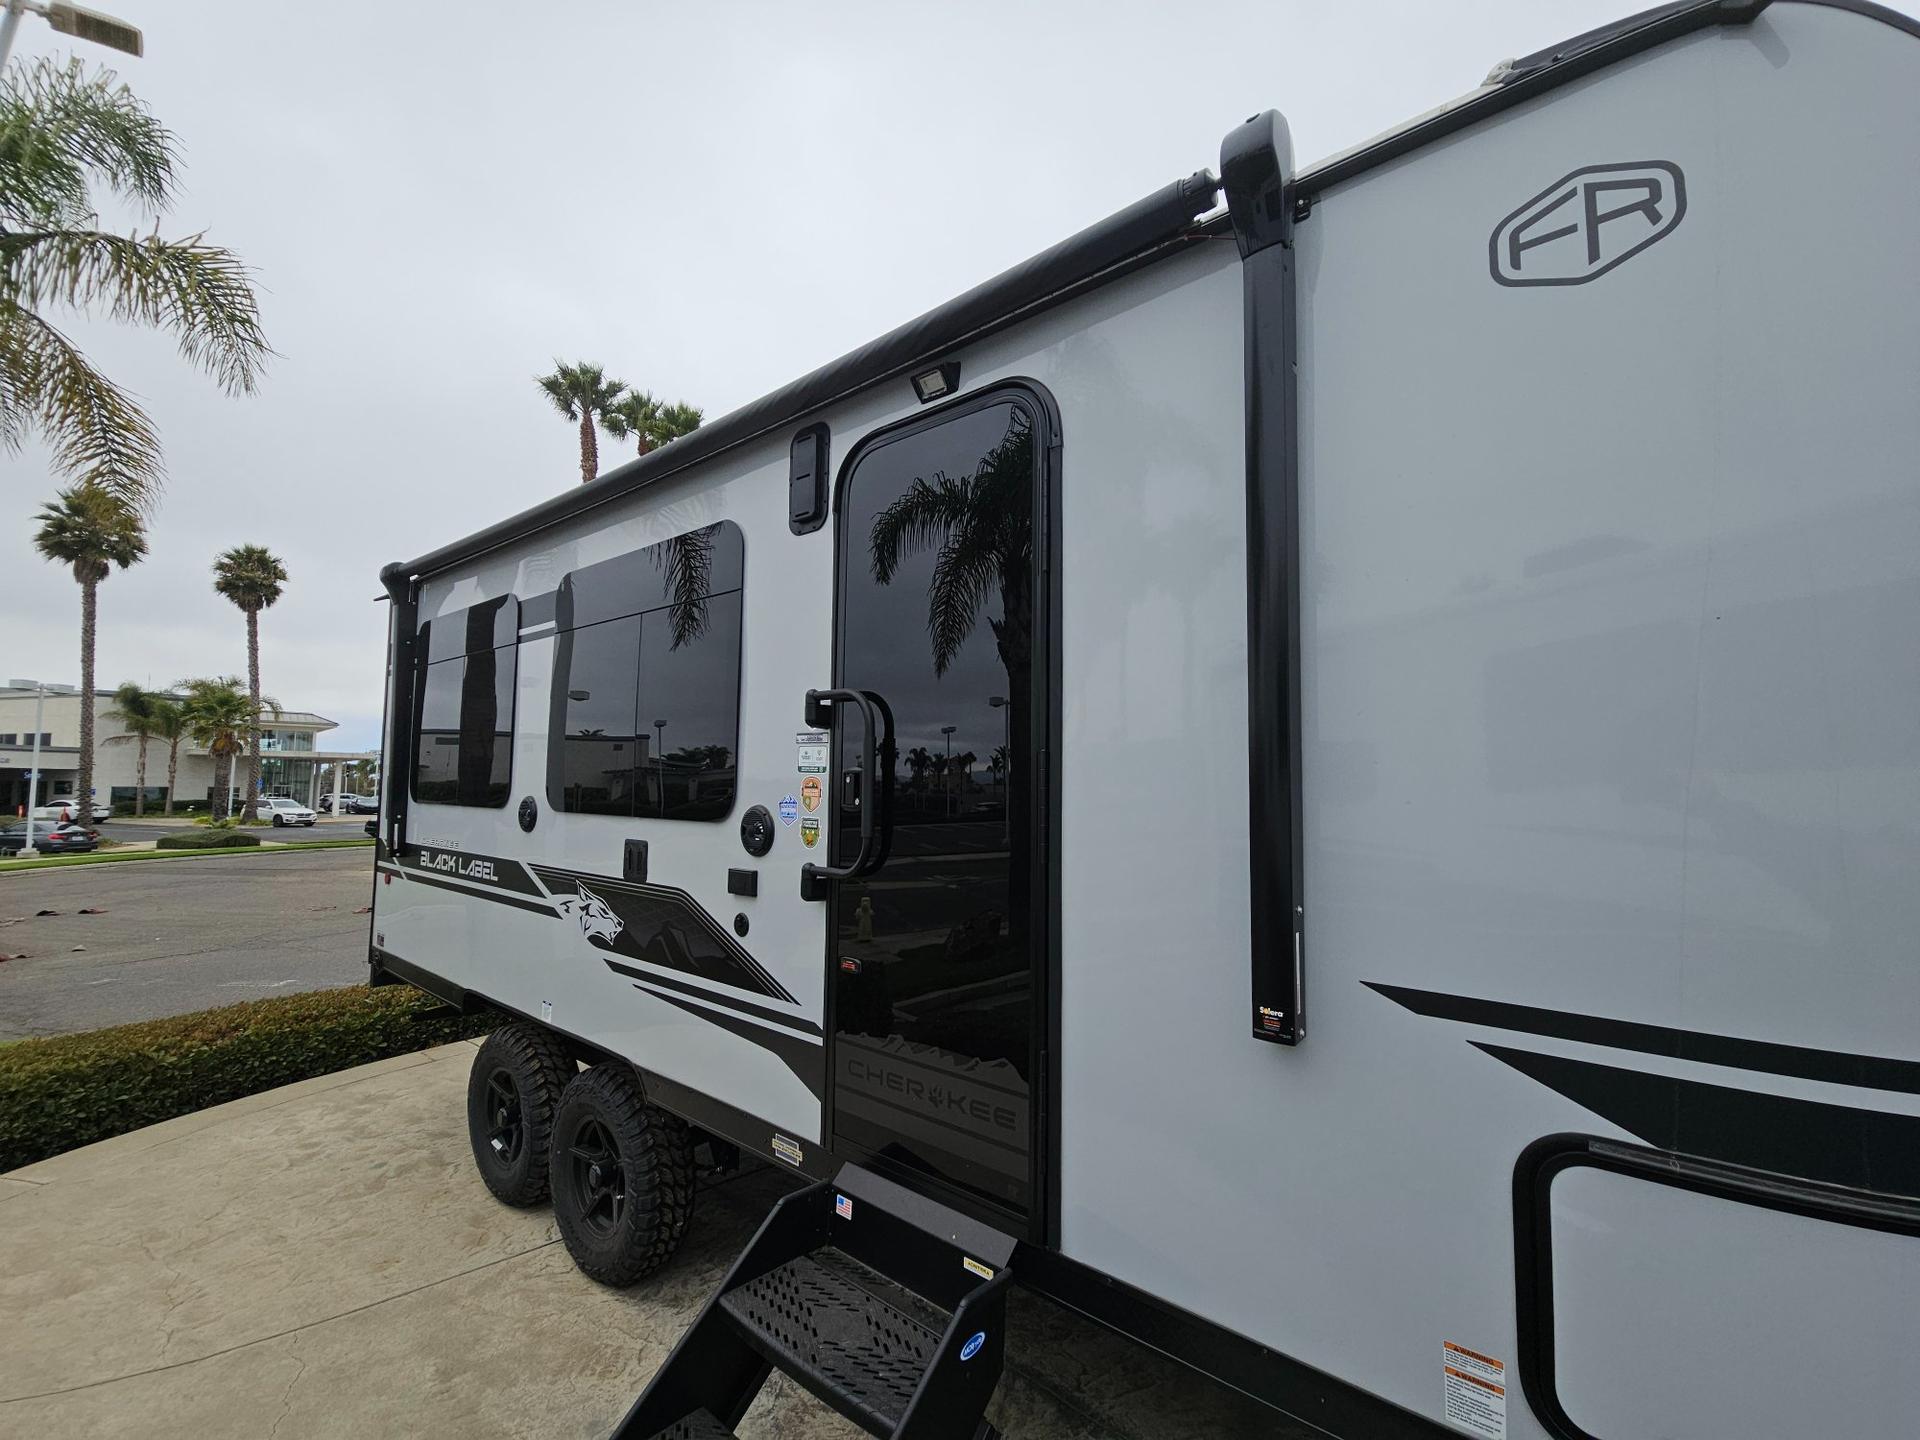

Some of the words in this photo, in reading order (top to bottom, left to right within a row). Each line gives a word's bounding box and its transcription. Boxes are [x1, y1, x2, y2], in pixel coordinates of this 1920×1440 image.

[420, 850, 457, 873] BLACK
[458, 857, 499, 882] LABEL
[1259, 1006, 1284, 1018] Solera
